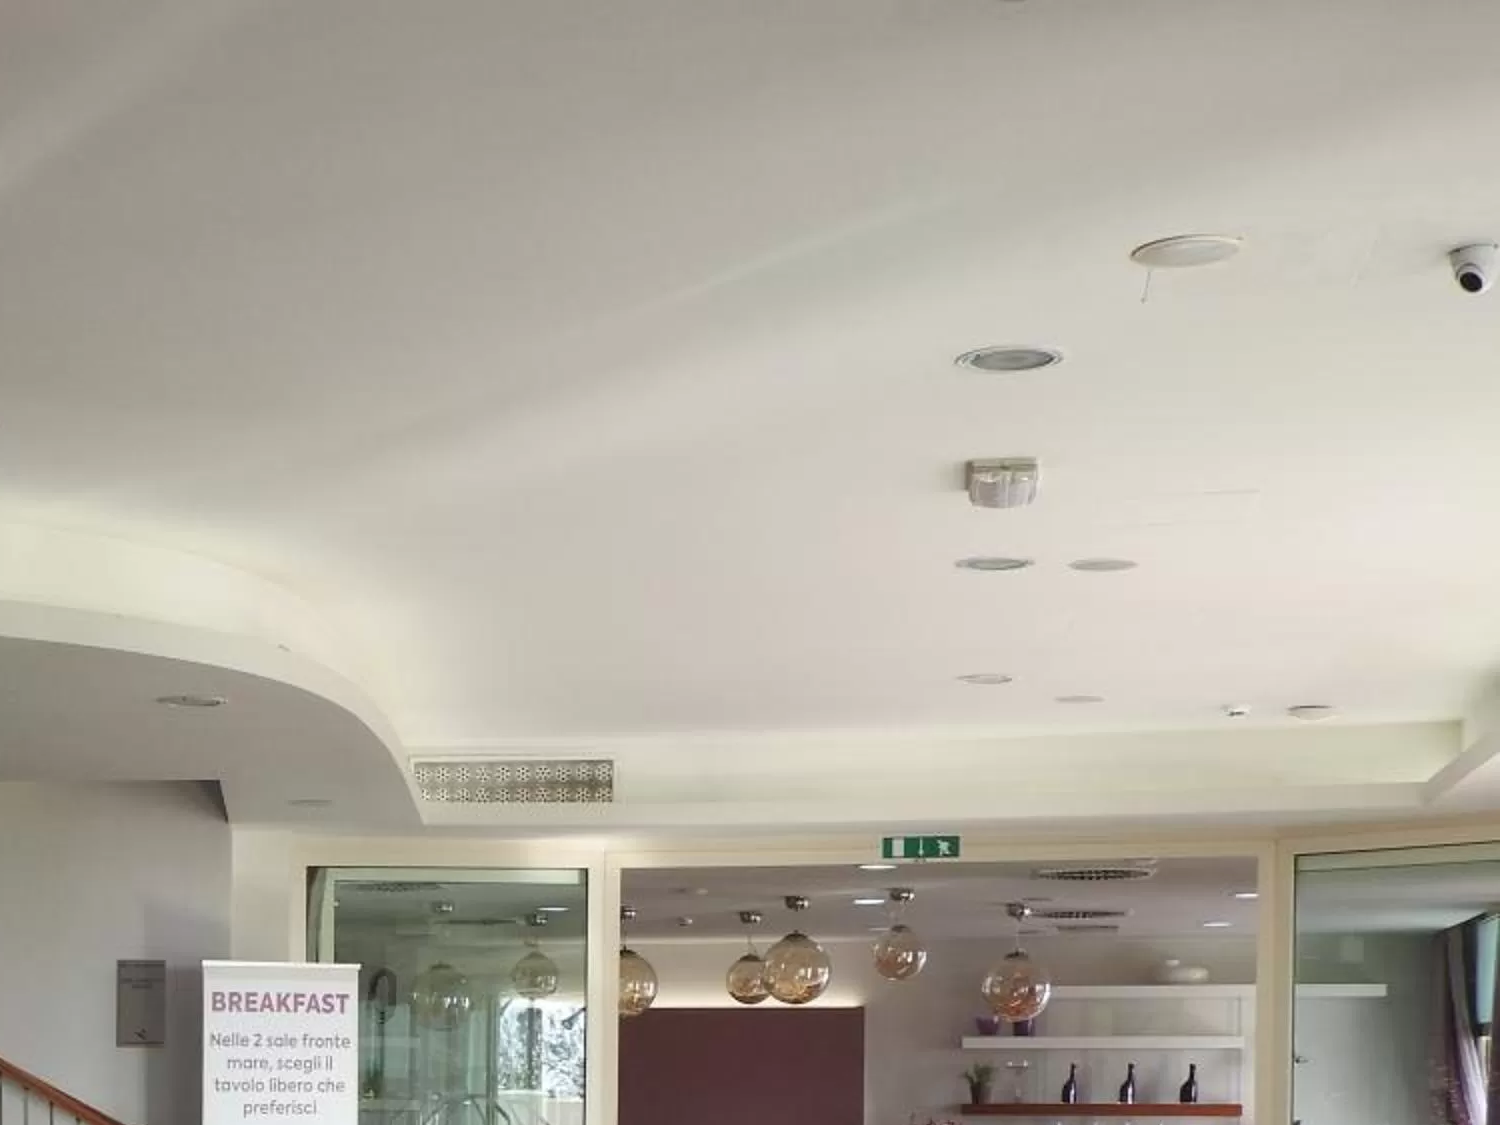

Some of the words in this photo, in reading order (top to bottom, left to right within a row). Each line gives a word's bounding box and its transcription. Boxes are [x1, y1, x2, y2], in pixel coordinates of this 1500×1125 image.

[211, 991, 350, 1015] BREAKFAST
[210, 1033, 249, 1048] Nelle
[254, 1033, 262, 1047] 2
[267, 1033, 297, 1048] sale
[302, 1033, 351, 1049] fronte
[227, 1057, 273, 1072] mare,
[277, 1056, 321, 1073] scegli
[325, 1056, 333, 1070] il
[215, 1079, 264, 1093] tavolo
[269, 1079, 313, 1093] libero
[317, 1079, 345, 1093] che
[243, 1100, 317, 1118] preferisci
